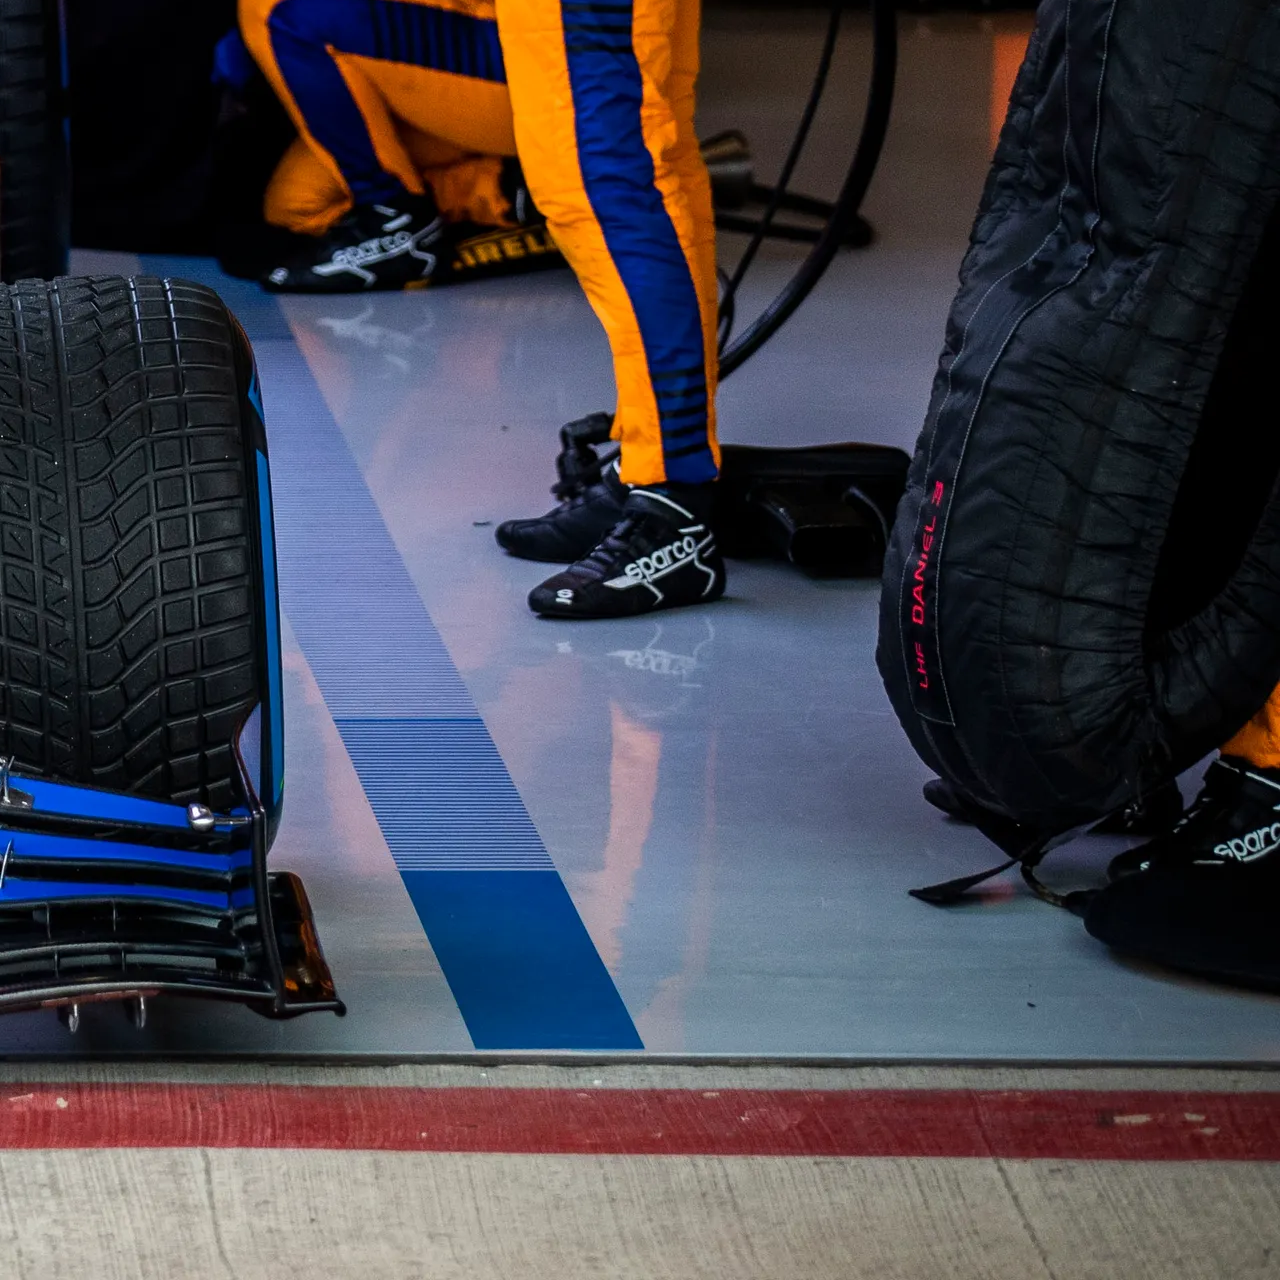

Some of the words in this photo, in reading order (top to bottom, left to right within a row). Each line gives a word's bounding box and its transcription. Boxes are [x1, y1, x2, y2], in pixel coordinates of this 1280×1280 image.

[621, 535, 696, 583] sparco
[912, 516, 937, 625] DANIEL
[917, 641, 929, 690] LHF
[1213, 822, 1280, 862] sparc
